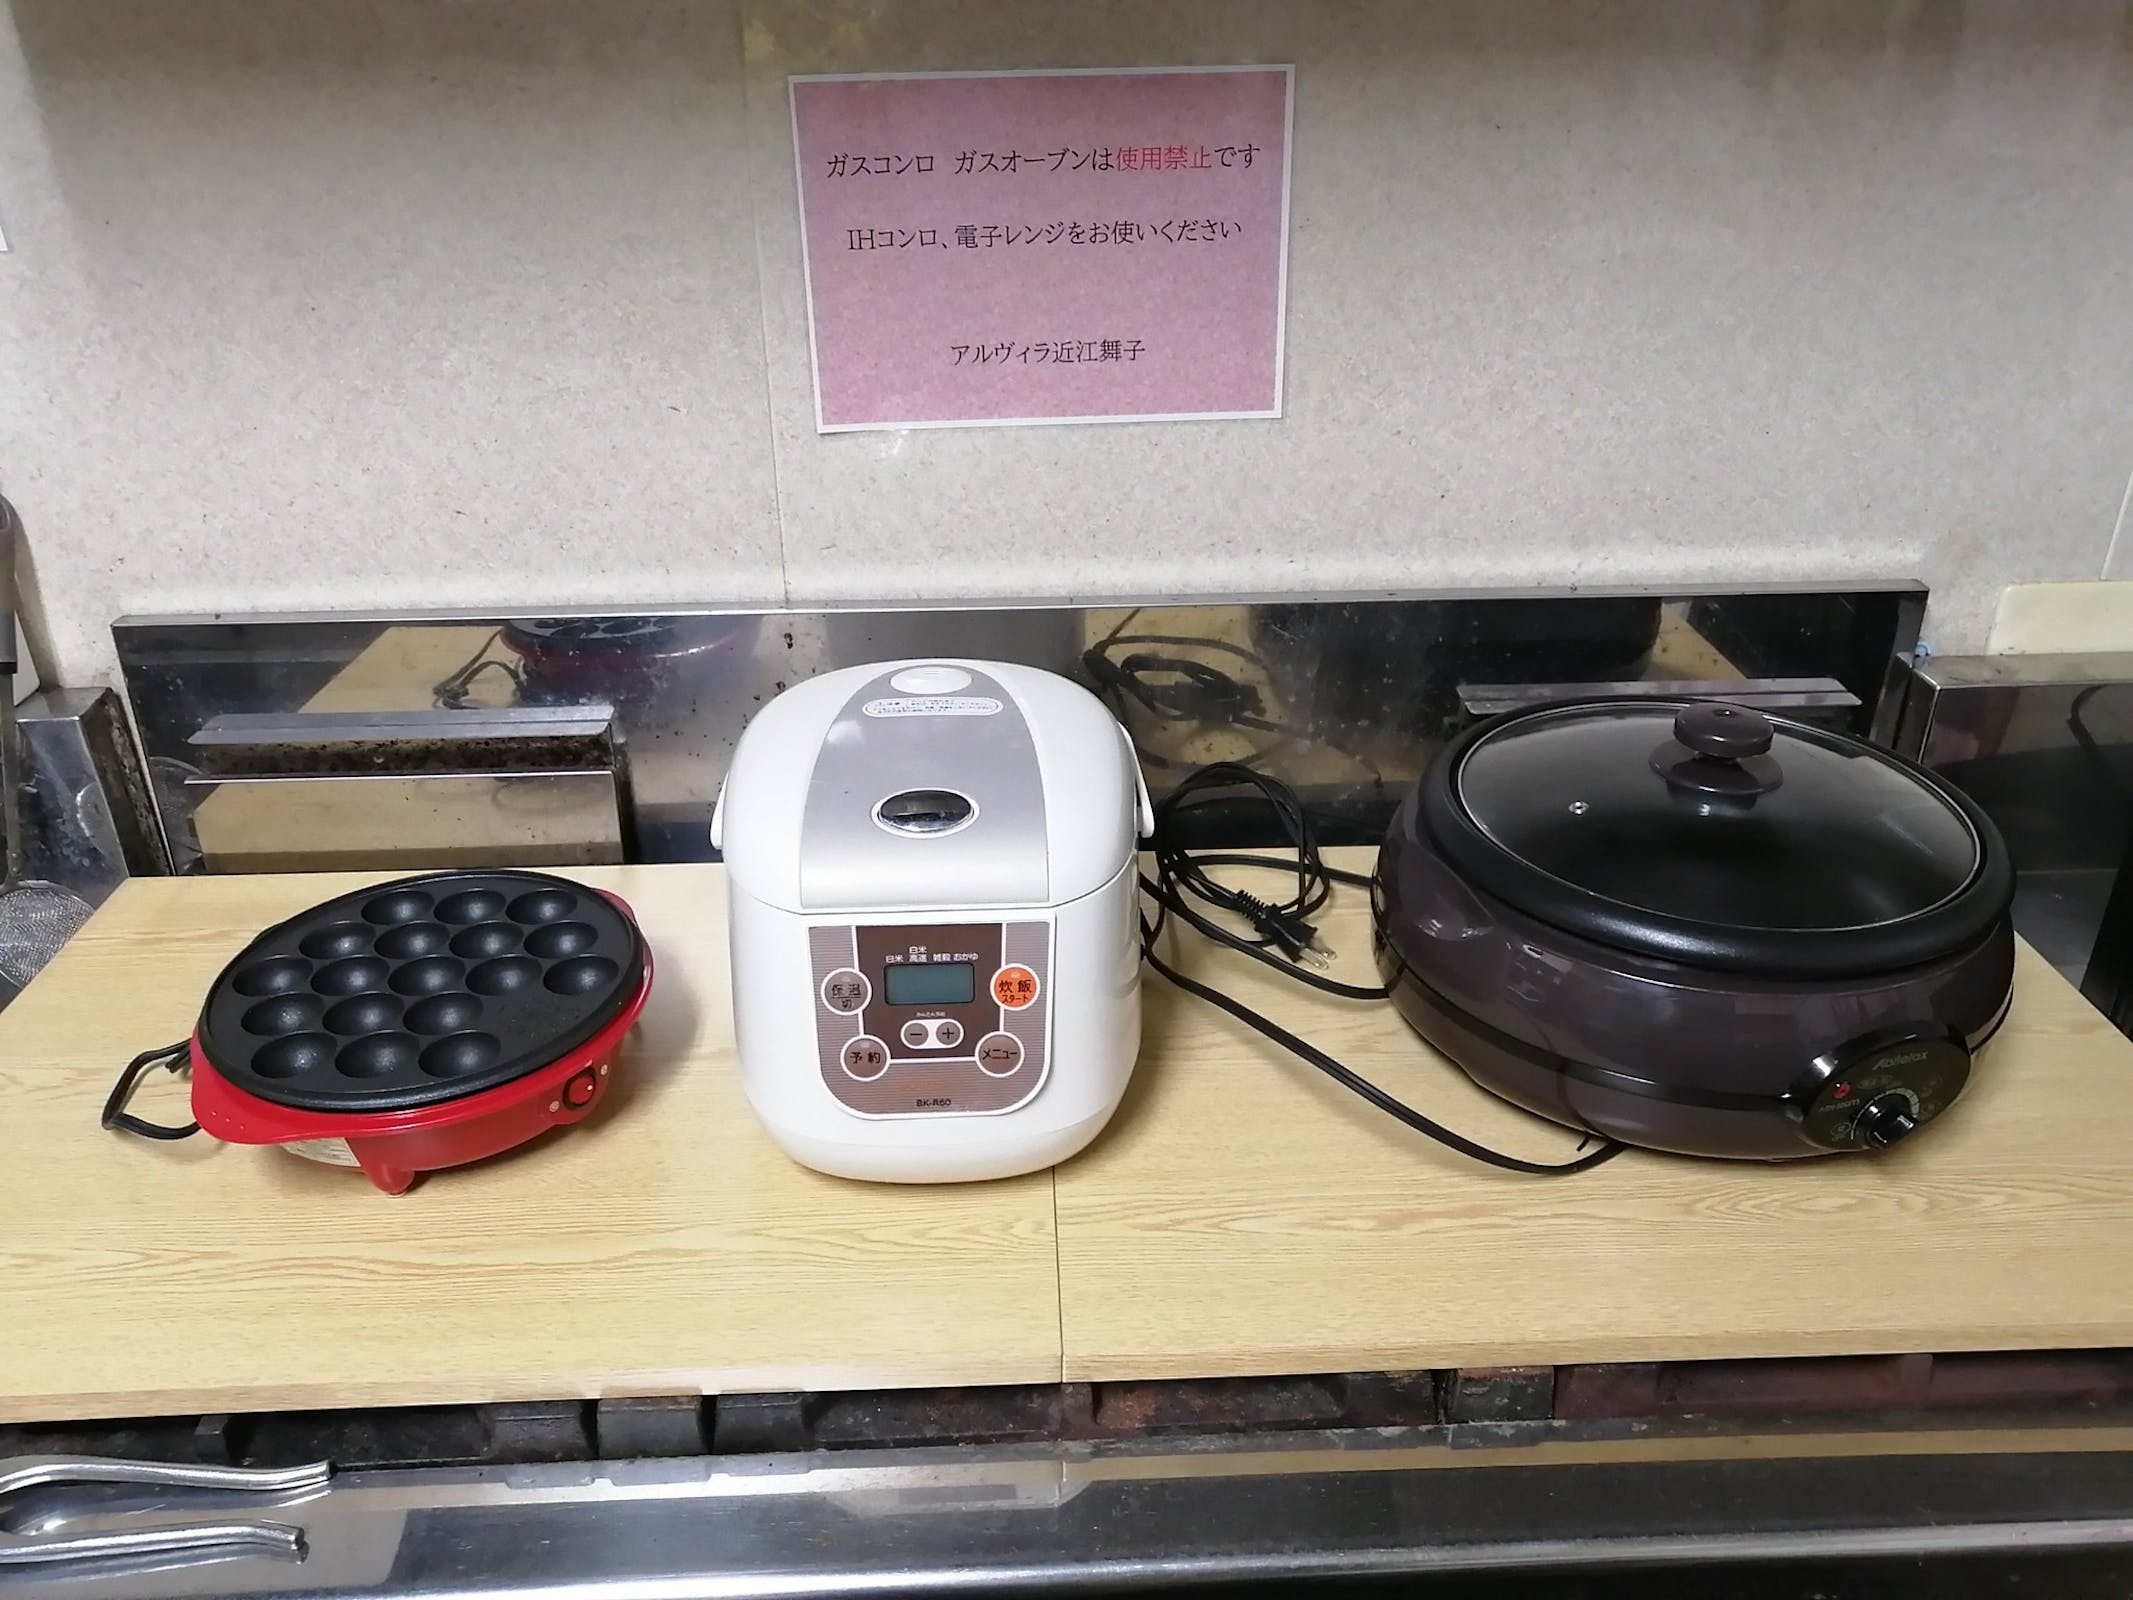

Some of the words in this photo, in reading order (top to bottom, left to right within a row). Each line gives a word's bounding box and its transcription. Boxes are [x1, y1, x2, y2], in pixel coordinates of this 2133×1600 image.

[826, 152, 935, 178] ガスコンロ
[954, 143, 1262, 174] ガスオーブンは使用禁止です
[848, 219, 1242, 251] IHコンロ、電子レンジをお使いください
[950, 338, 1146, 366] アルヴィラ近江舞子
[998, 979, 1032, 994] 炊飯
[1001, 994, 1029, 1004] スタート
[982, 1048, 1018, 1060] メニュー
[916, 1098, 952, 1107] BK-R60
